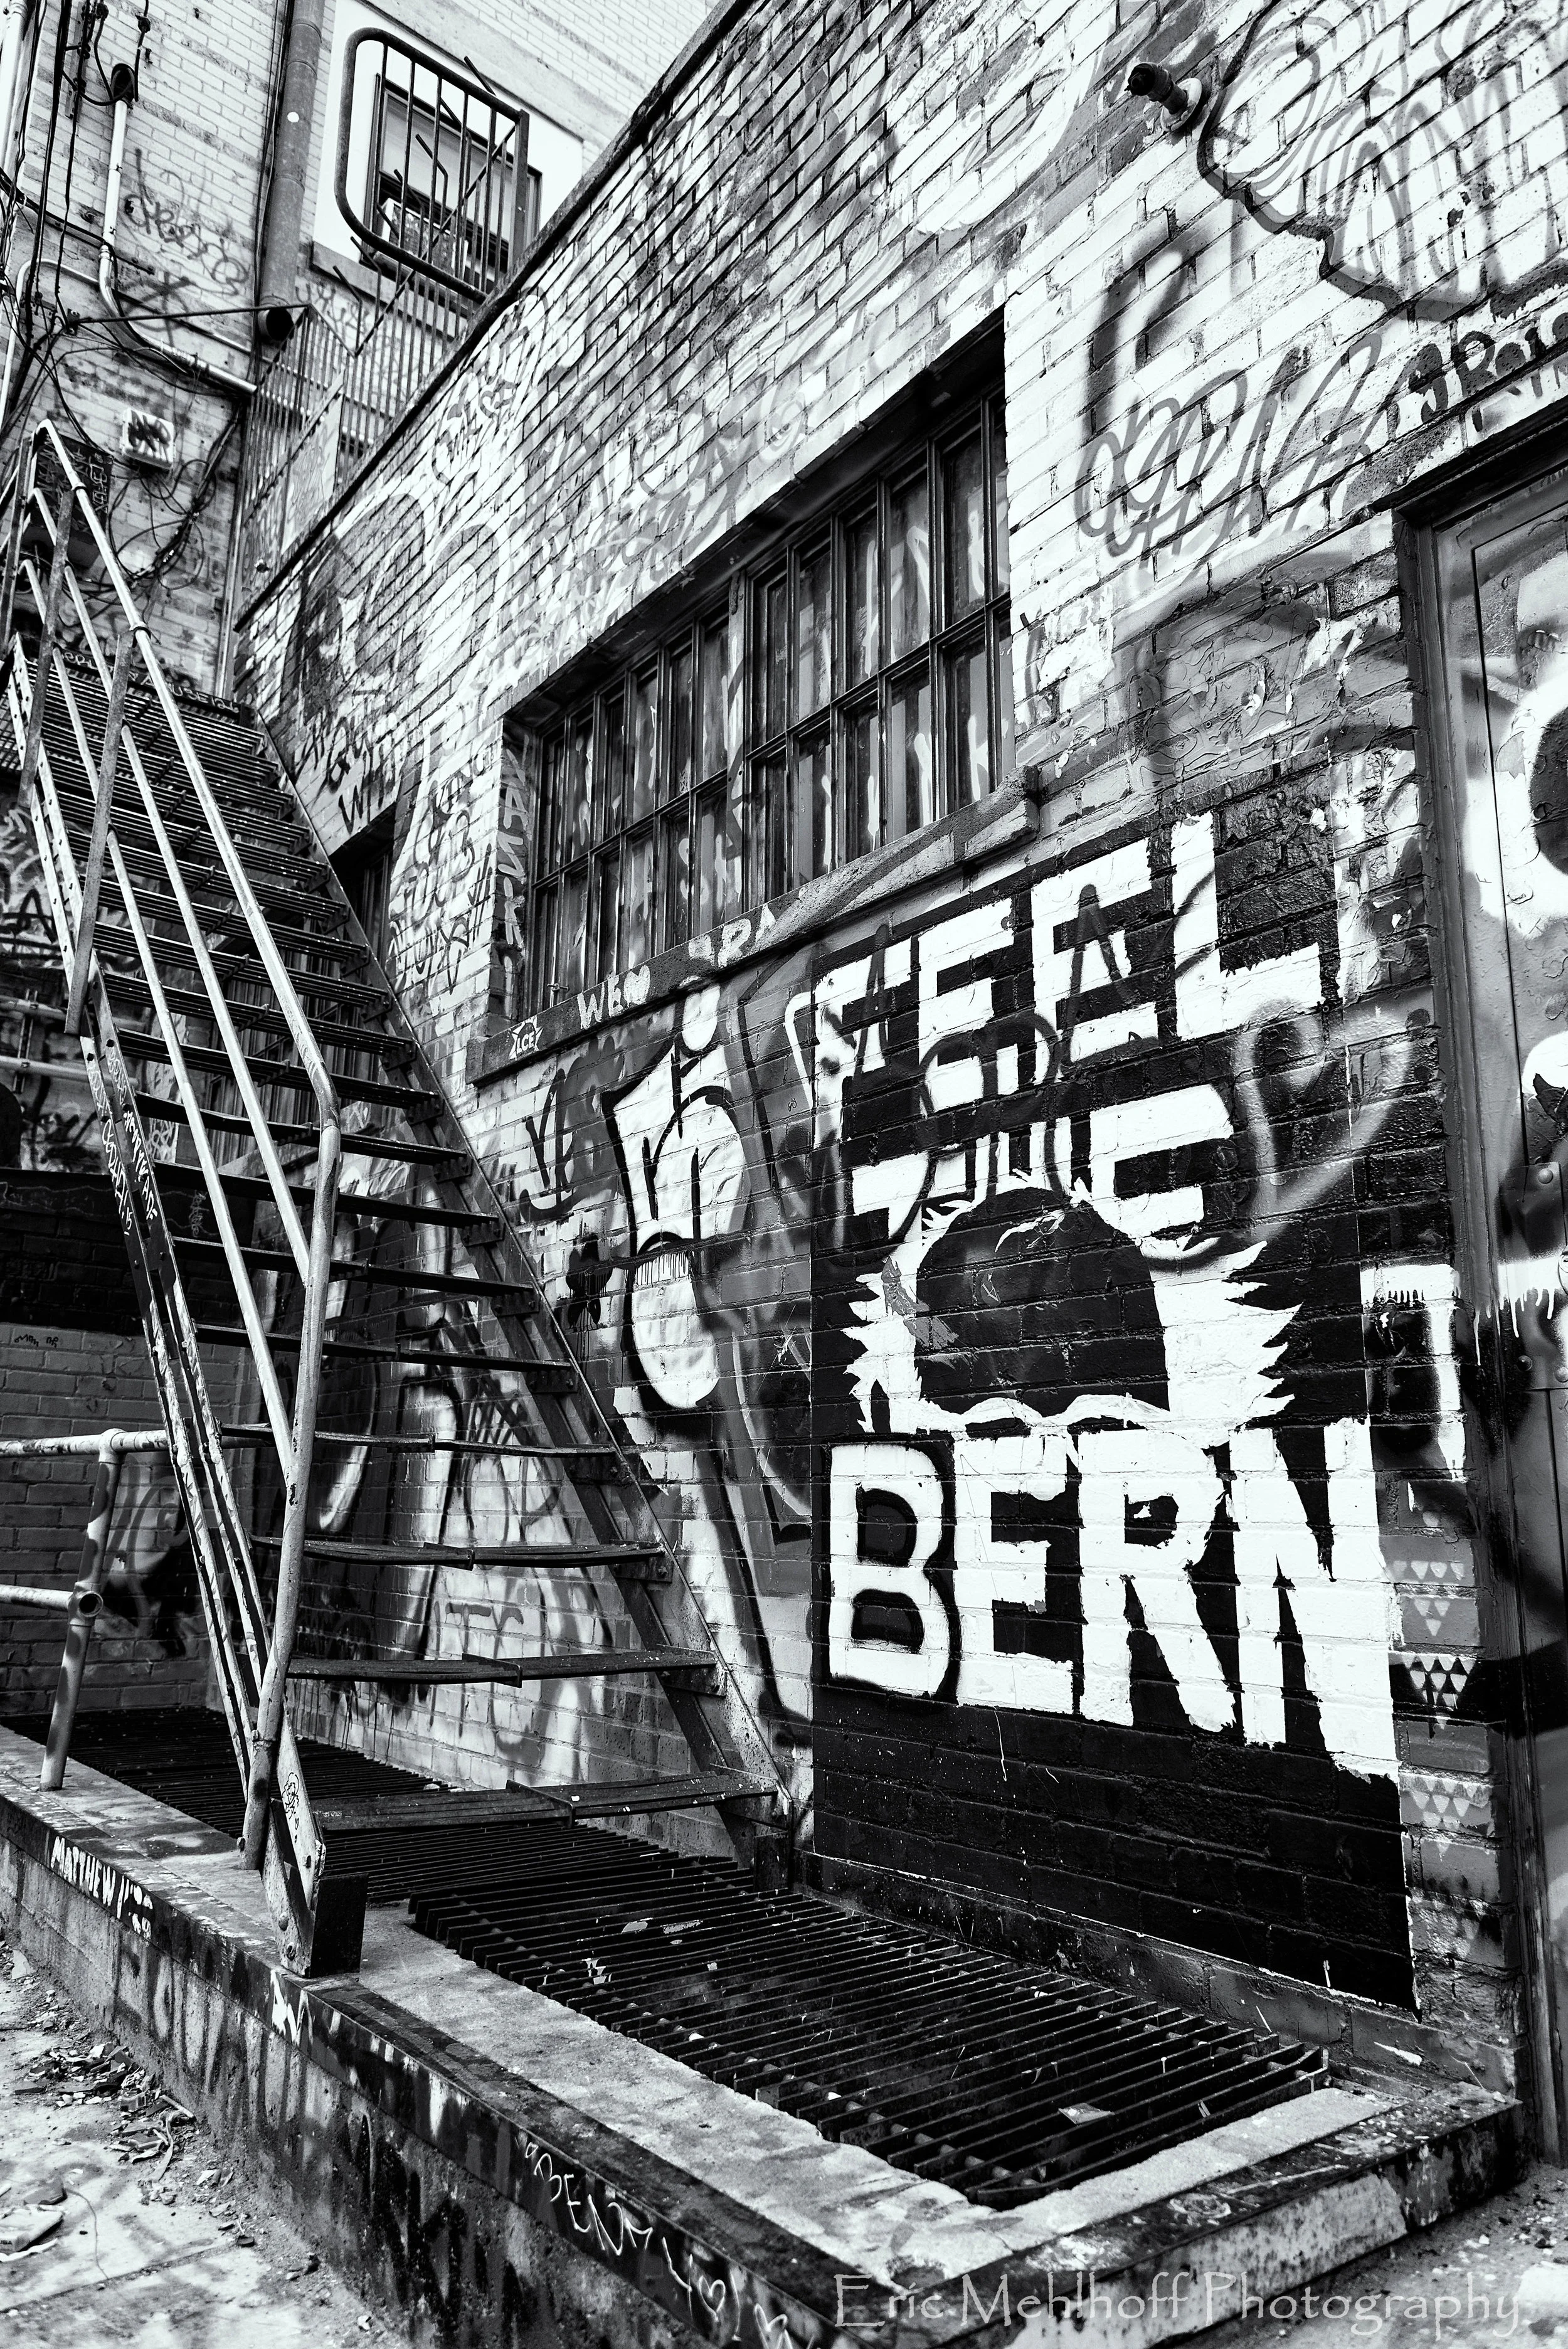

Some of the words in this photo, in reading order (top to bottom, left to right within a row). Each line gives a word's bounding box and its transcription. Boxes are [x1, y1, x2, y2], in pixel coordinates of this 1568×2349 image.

[815, 813, 1325, 1148] FEEL
[852, 1083, 1234, 1242] THE
[829, 1418, 1400, 1781] BERN
